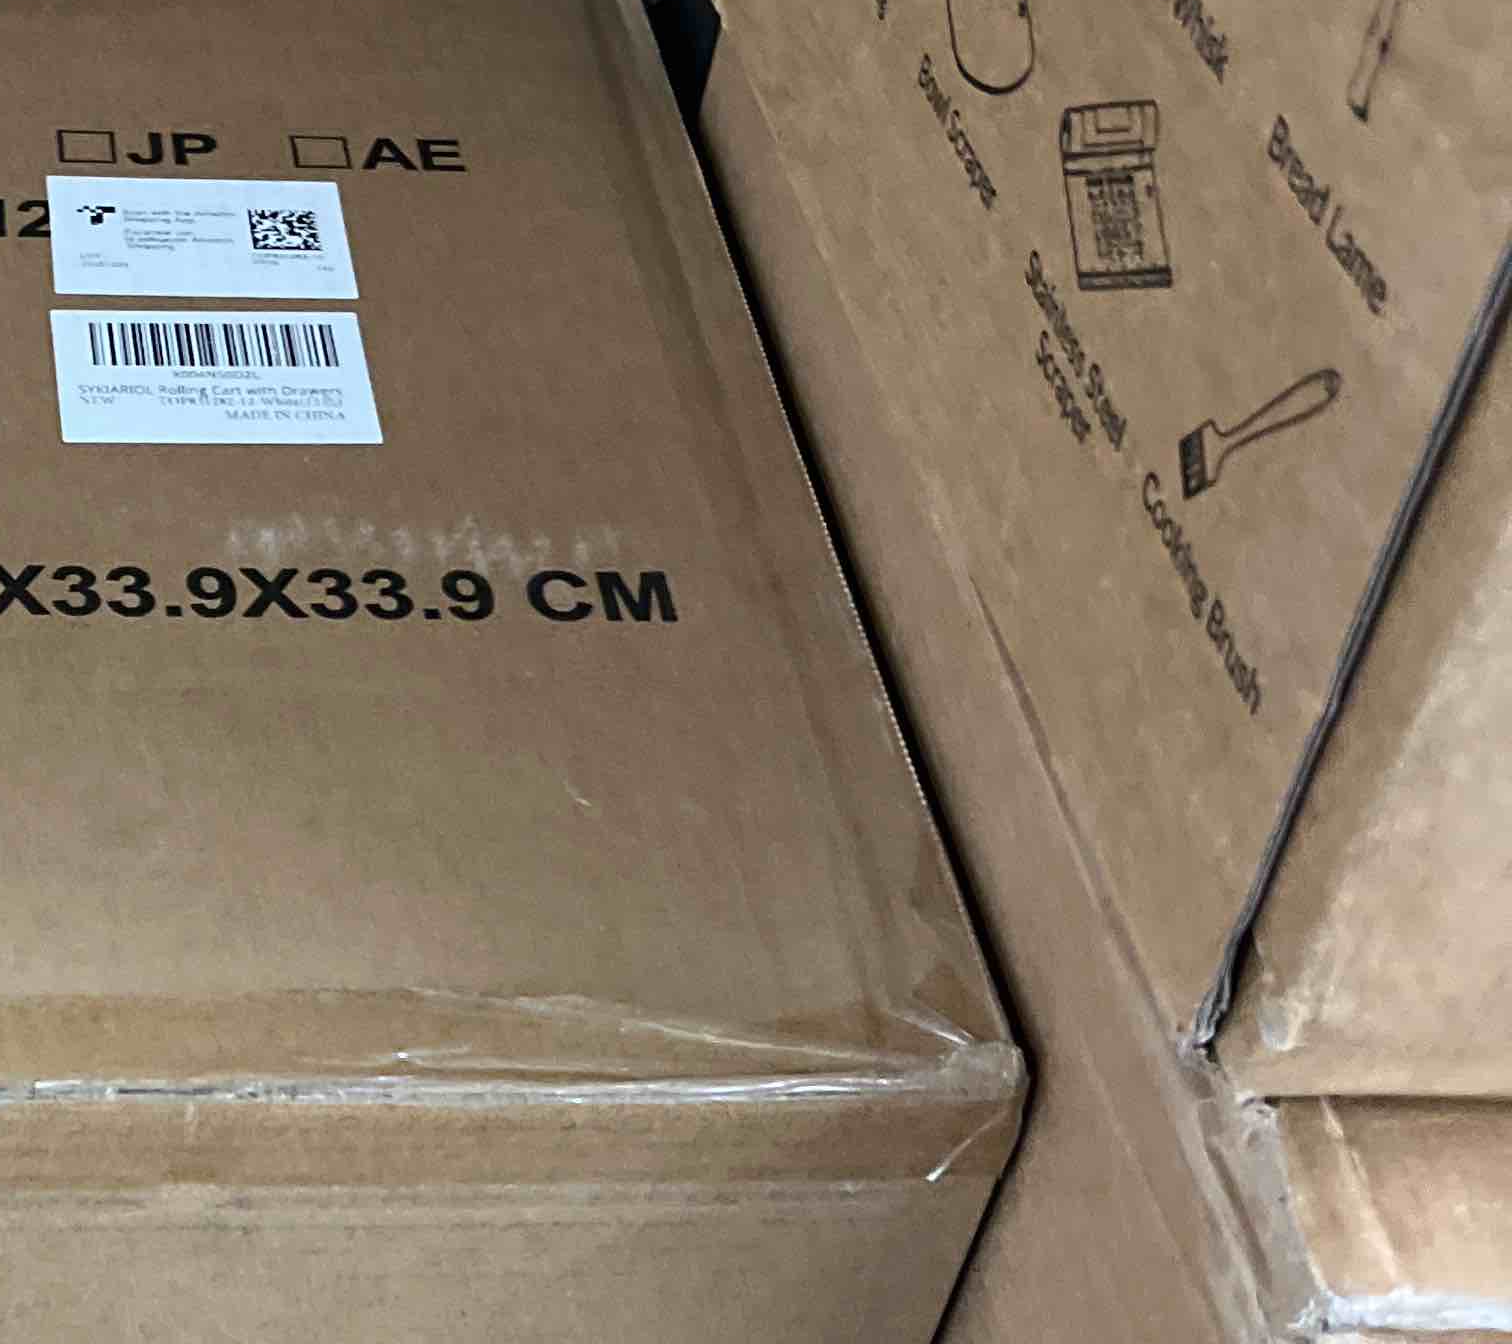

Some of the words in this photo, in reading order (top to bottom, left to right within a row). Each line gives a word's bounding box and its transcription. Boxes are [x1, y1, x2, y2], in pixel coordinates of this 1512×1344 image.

[126, 132, 218, 166] JP
[361, 137, 468, 173] AE
[1268, 112, 1330, 226] Bread
[1326, 204, 1388, 316] Lame
[158, 384, 207, 399] Rolling
[211, 384, 241, 396] Cart
[525, 568, 679, 623] CM
[1143, 470, 1209, 621] Cooking
[1206, 598, 1262, 716] Brush
